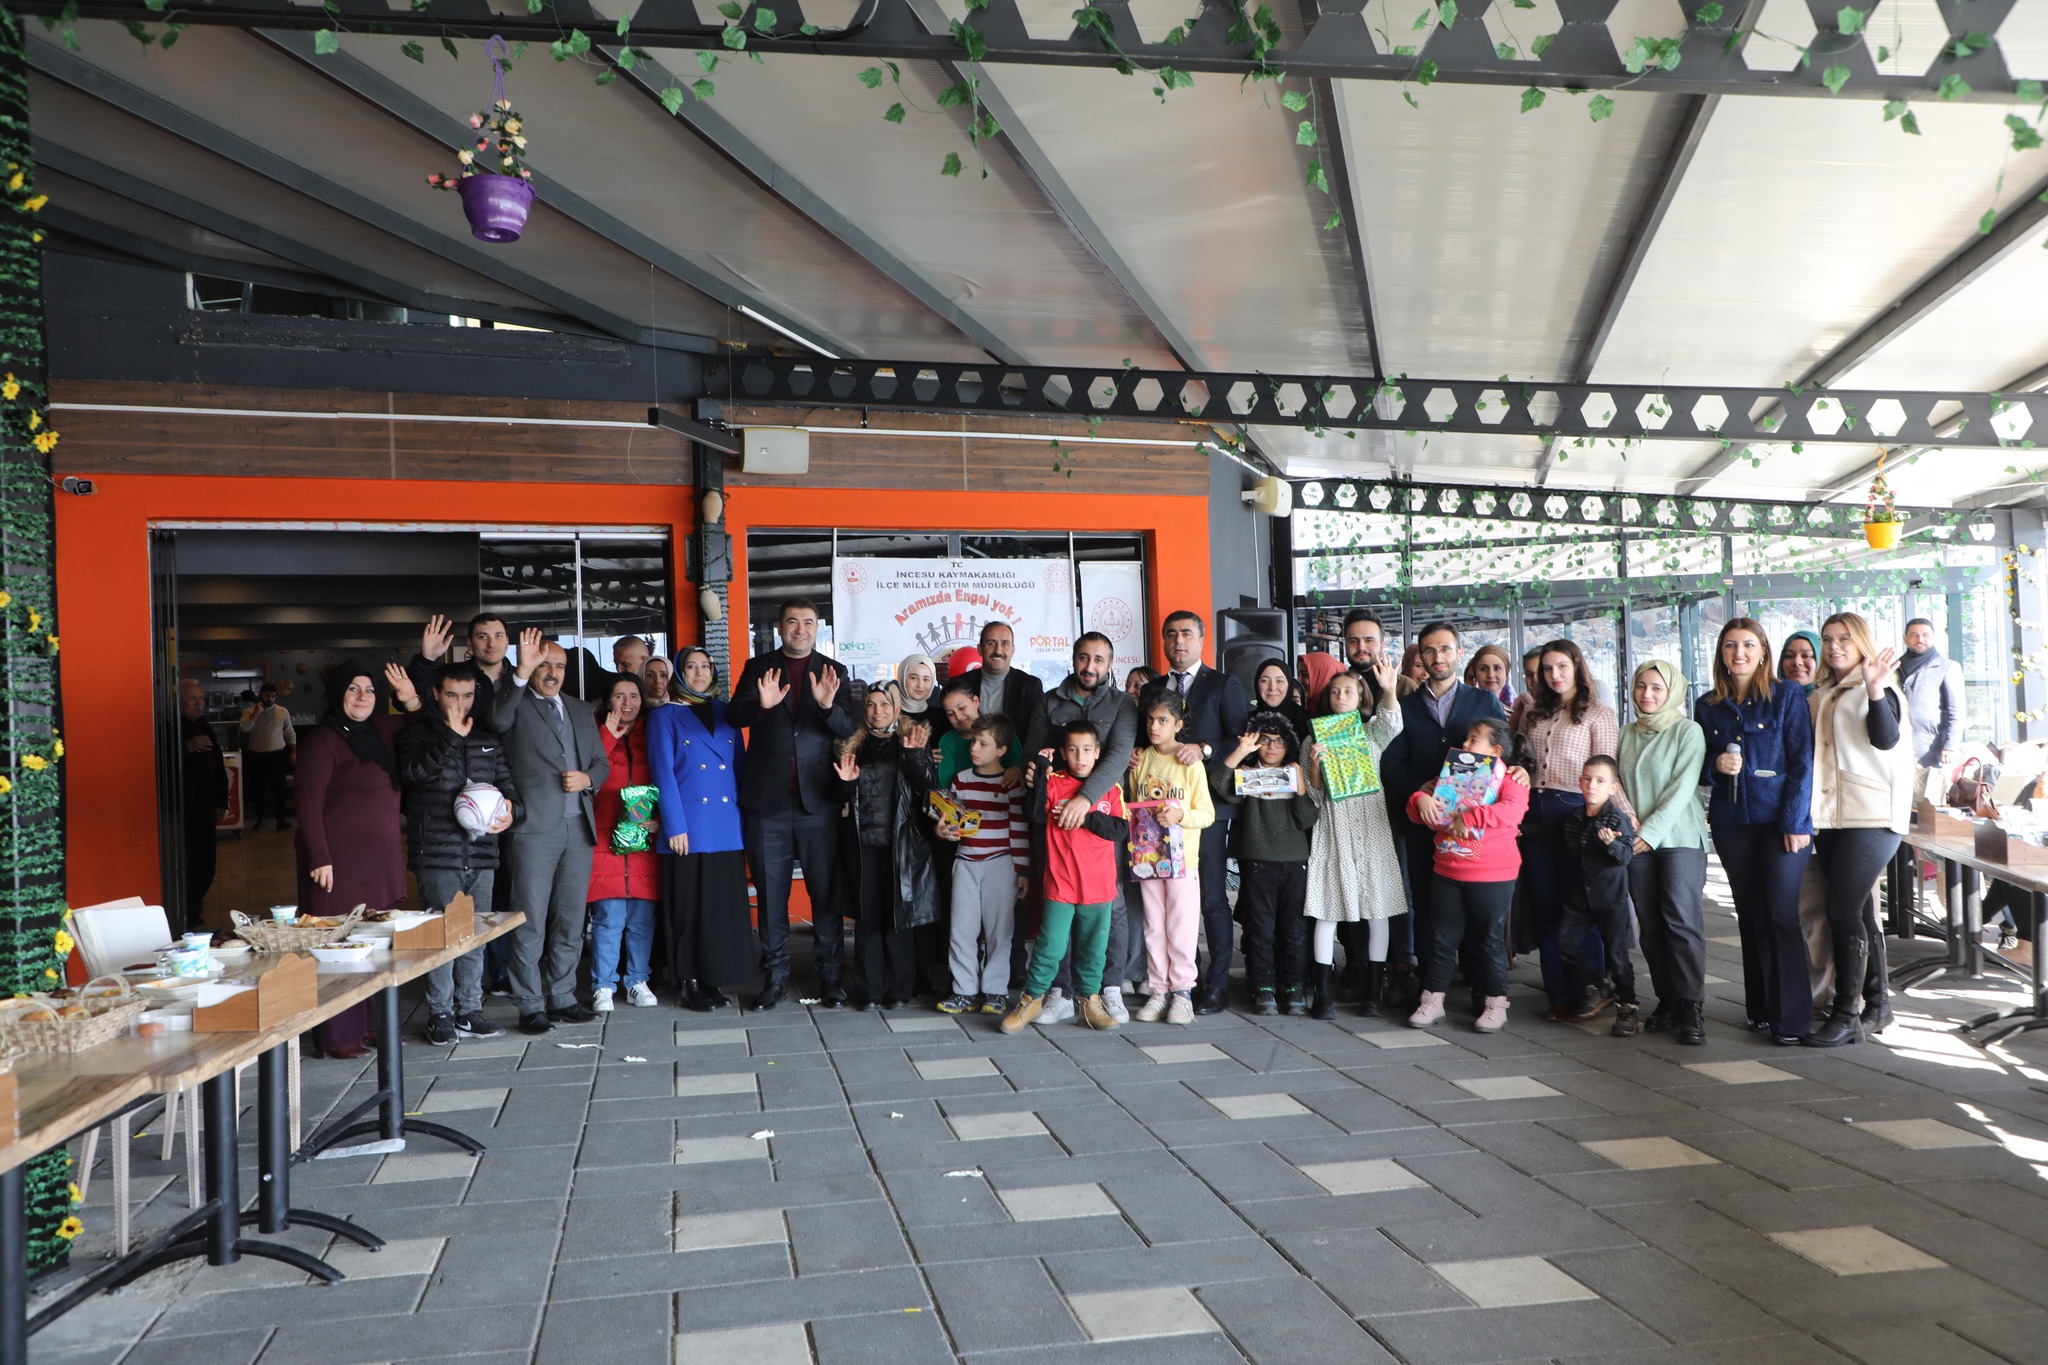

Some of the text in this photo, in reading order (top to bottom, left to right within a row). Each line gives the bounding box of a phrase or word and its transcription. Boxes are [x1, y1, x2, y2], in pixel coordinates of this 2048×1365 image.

[896, 570, 1016, 579] İNCESU KAYMAKAMLIĞI
[876, 580, 1036, 590] İLÇE MİLLİ EĞİTİM MÜDÜRLÜĞÜ
[894, 590, 952, 627] Aramızda
[955, 588, 990, 607] Engel
[990, 599, 1015, 619] yok
[1029, 634, 1071, 648] PORTAL
